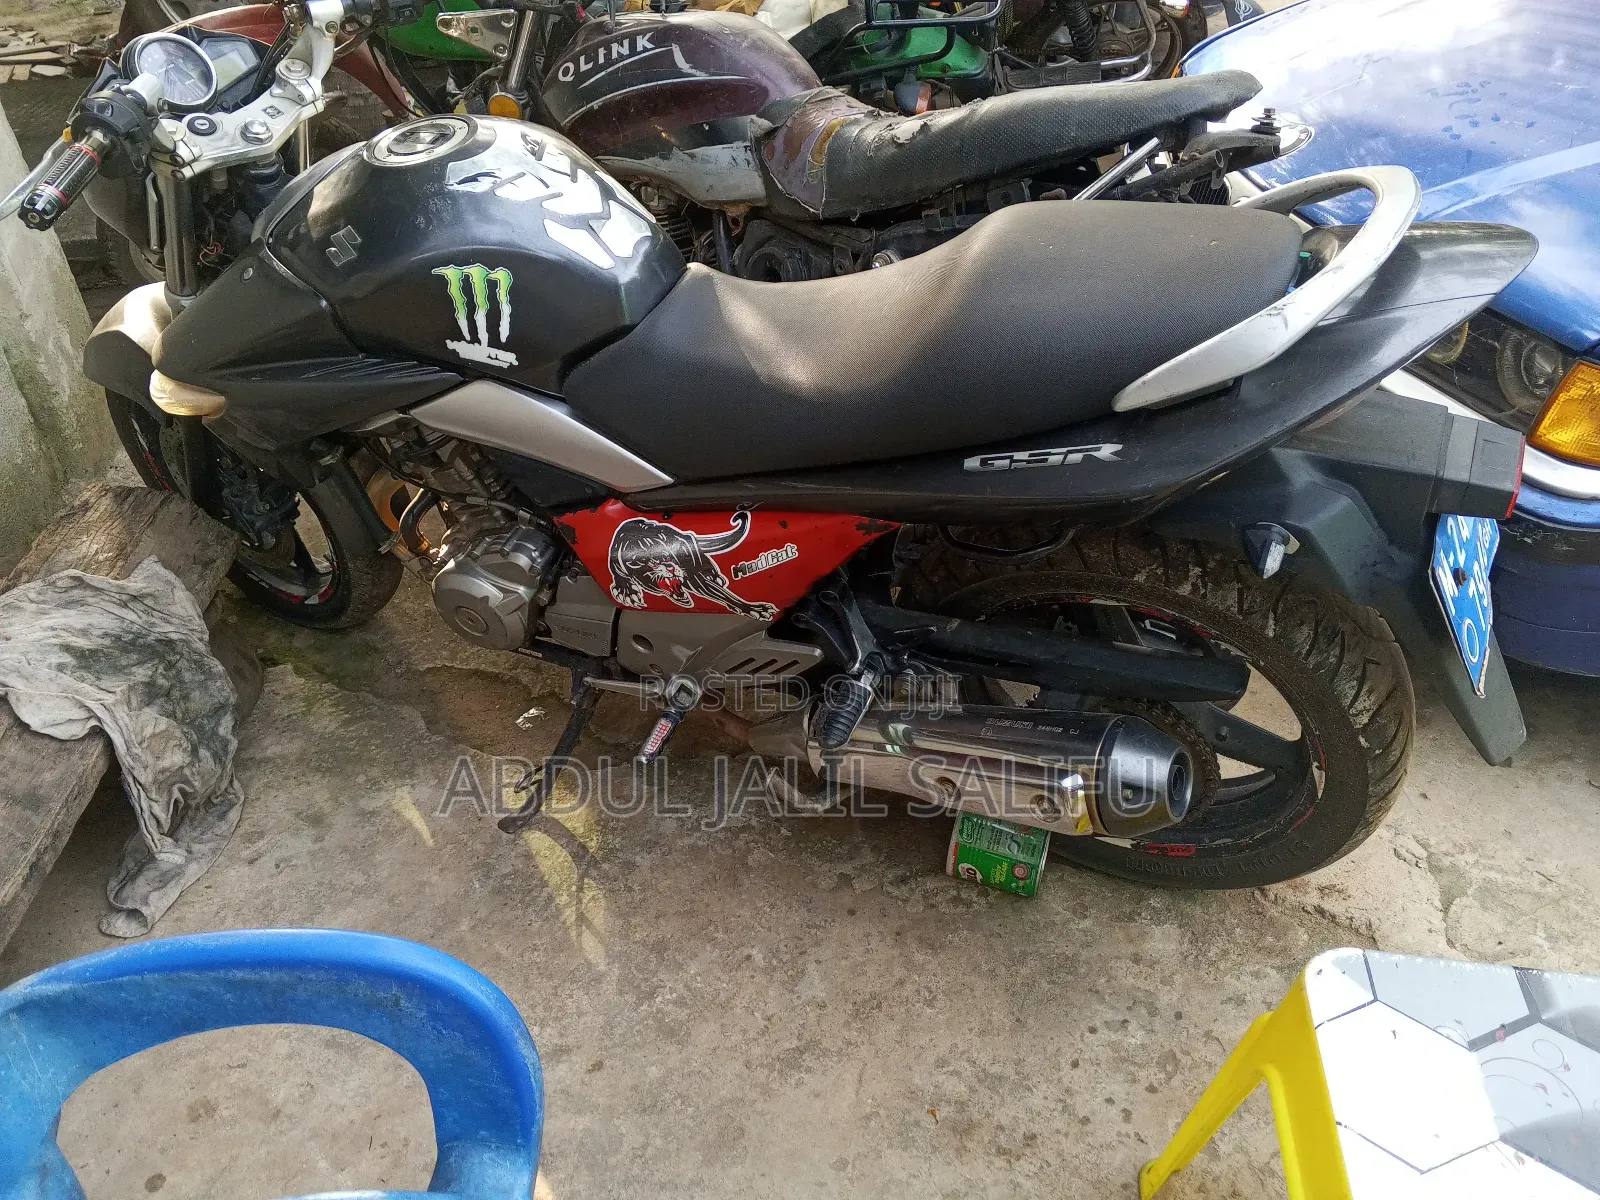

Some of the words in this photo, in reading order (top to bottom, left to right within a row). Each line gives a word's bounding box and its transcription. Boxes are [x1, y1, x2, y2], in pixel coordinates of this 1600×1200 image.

[557, 31, 656, 82] QLINK
[963, 443, 1125, 472] GSR
[731, 543, 799, 580] MadCat
[985, 717, 1034, 730] SUZUKI
